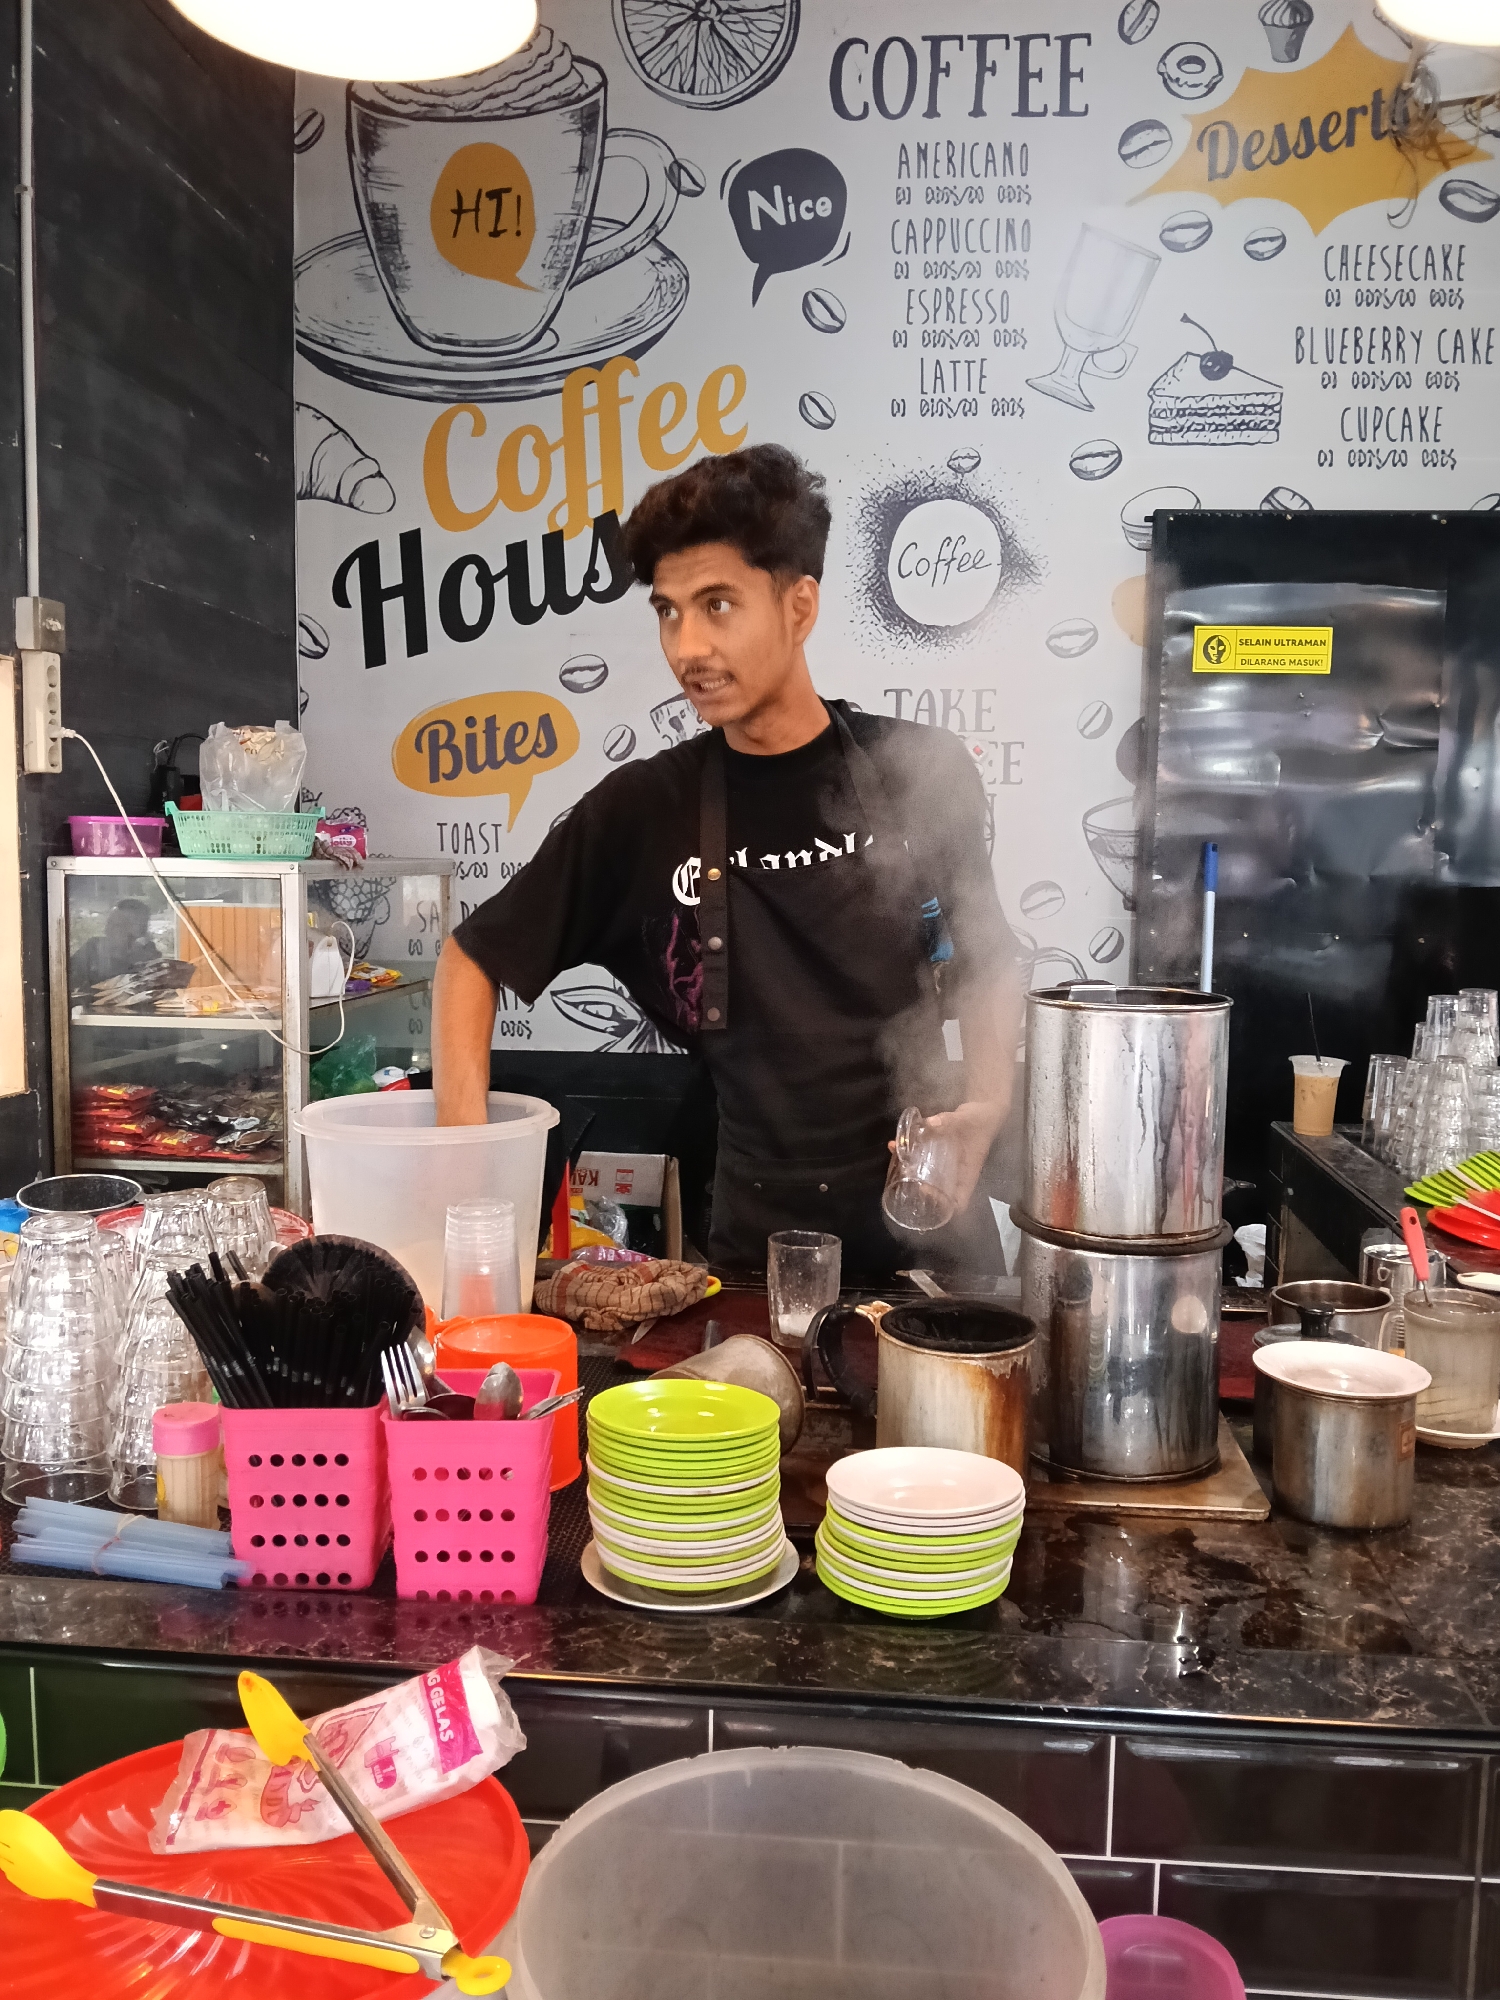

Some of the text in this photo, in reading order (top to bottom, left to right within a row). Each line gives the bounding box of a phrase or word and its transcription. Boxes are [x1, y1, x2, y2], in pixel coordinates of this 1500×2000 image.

[829, 33, 1092, 121] COFFEE
[898, 140, 1029, 179] AMERICANO
[451, 187, 522, 238] HI!
[748, 185, 832, 231] Nice
[891, 217, 1031, 255] CAPPUCCINO
[1324, 244, 1466, 281] CHEESECAKE
[906, 287, 1010, 325] ESPRESSO
[1295, 326, 1495, 365] BLUEBERRY CAKE
[921, 357, 987, 394] LATTE
[1341, 406, 1443, 442] CUPCAKE
[423, 355, 749, 542] Coffee
[898, 535, 992, 587] Coffee
[332, 508, 632, 669] Hous
[1238, 638, 1327, 647] SELAIN ULTRAMAN
[1240, 658, 1324, 667] DILARANG MASUK!
[415, 712, 558, 784] Bites
[437, 822, 502, 855] TOAST
[430, 1687, 455, 1743] GELAS
